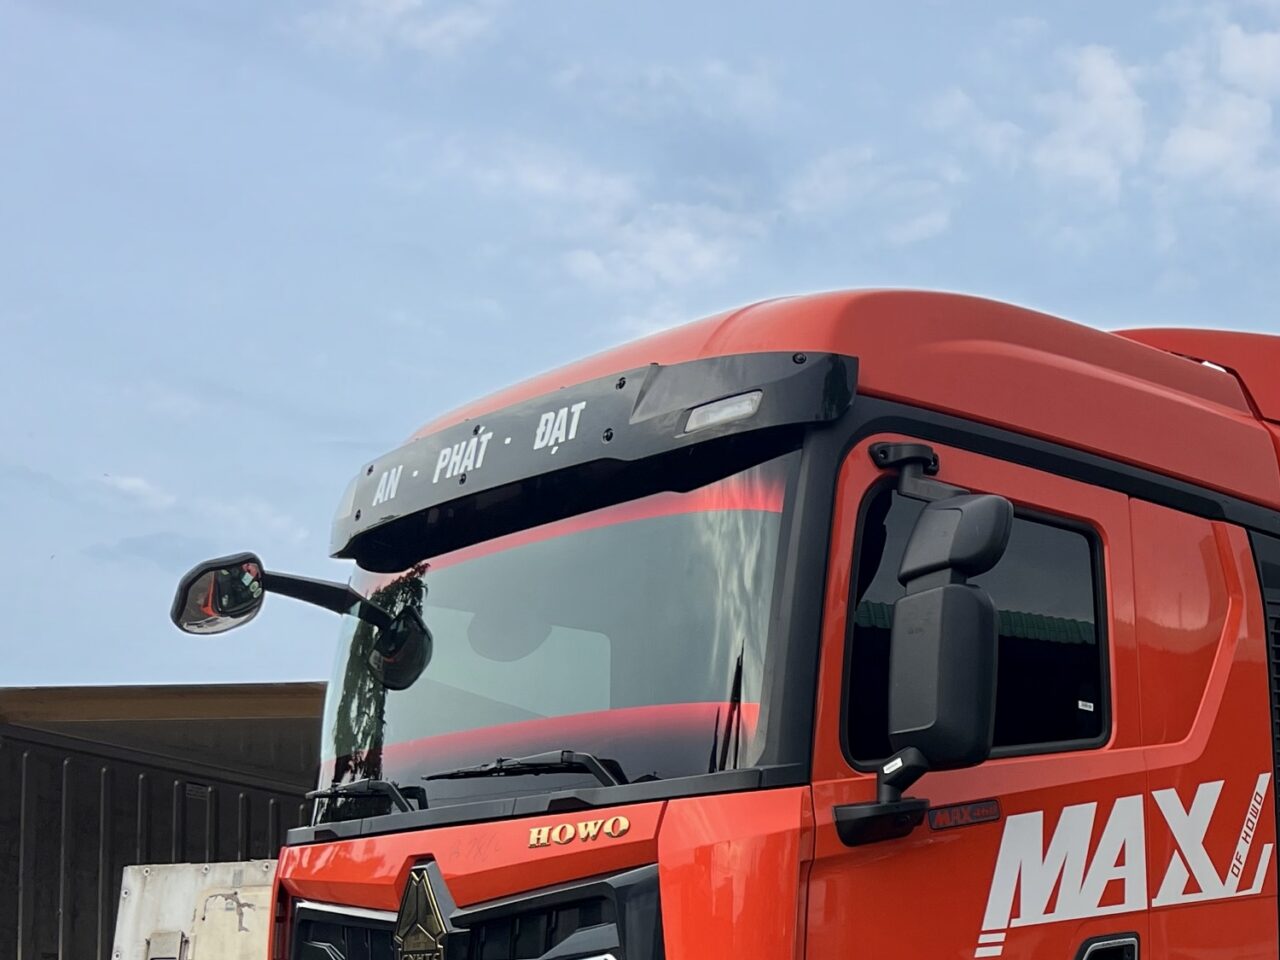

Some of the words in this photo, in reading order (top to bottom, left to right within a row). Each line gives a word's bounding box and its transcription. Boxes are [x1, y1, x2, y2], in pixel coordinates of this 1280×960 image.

[372, 465, 403, 507] AN
[432, 426, 493, 484] PHÁT
[533, 401, 587, 455] ĐẠT
[528, 816, 631, 849] HOWO
[979, 779, 1230, 929] MAX
[1230, 849, 1244, 879] OF
[1241, 792, 1264, 845] HOWO
